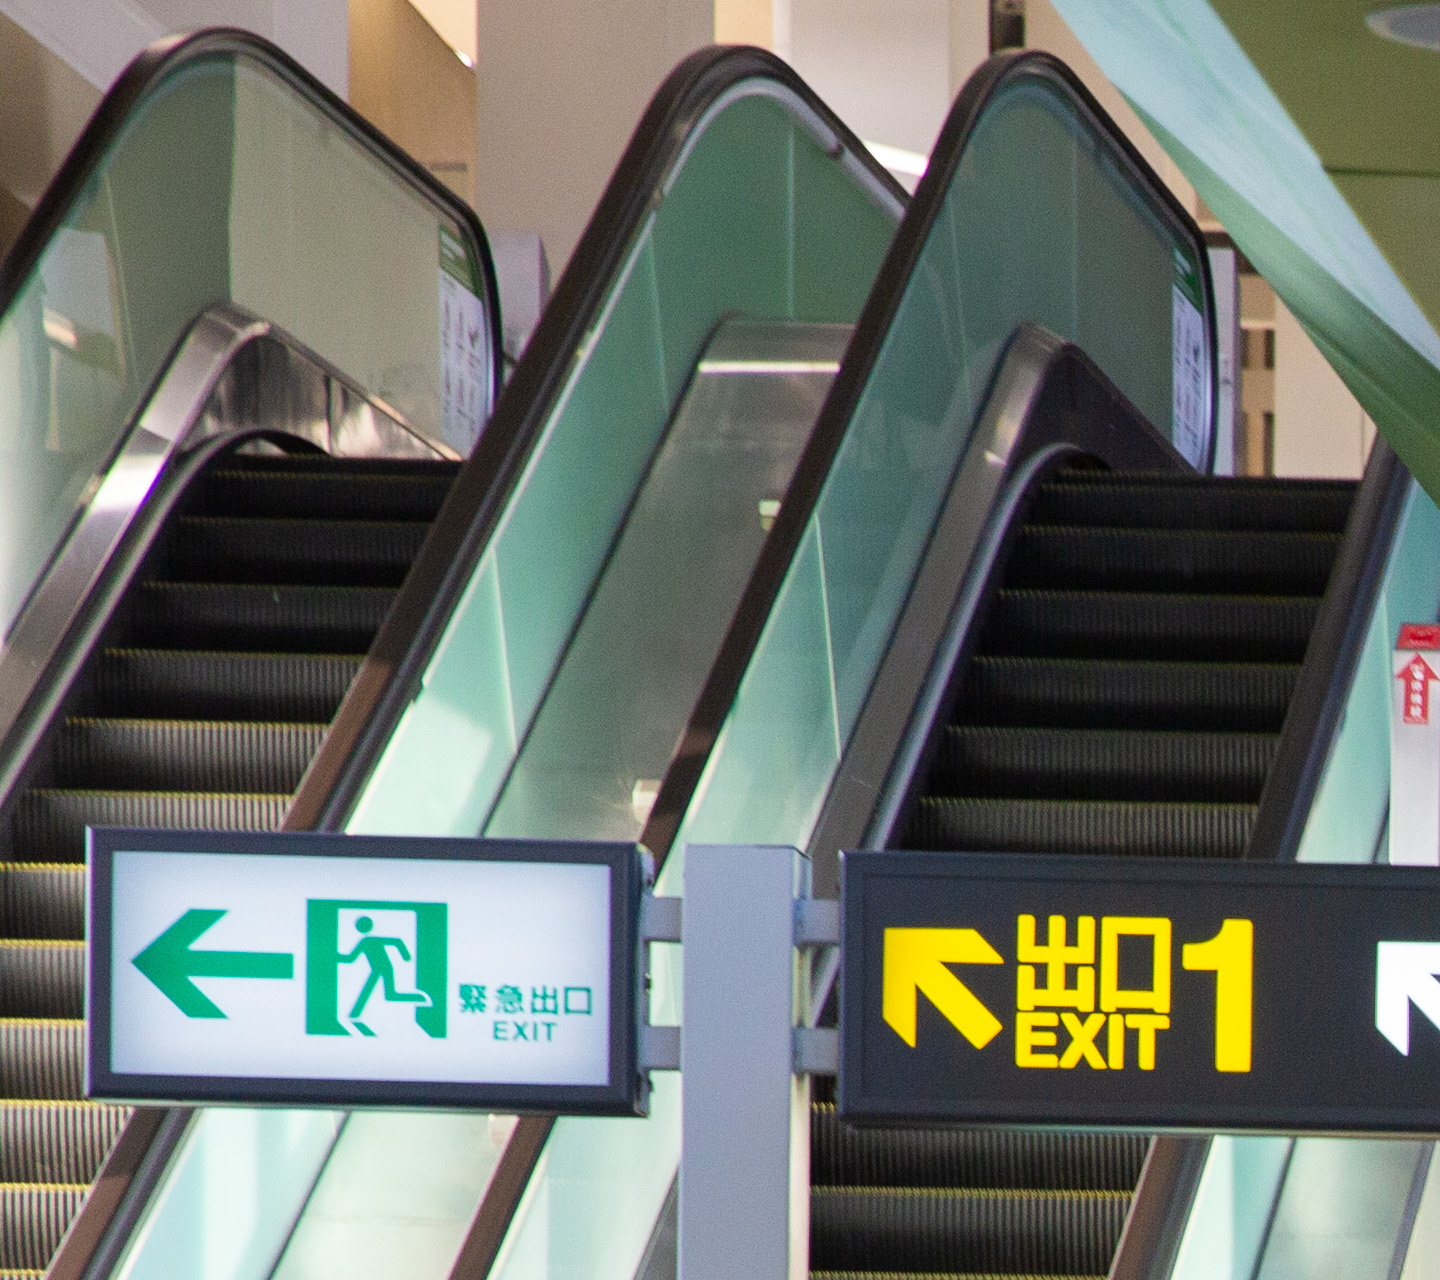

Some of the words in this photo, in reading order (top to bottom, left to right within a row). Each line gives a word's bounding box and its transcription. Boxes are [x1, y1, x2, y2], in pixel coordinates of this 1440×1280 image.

[460, 984, 592, 1015] 緊急出口
[1016, 914, 1172, 1014] 出口
[1182, 918, 1254, 1072] 1
[494, 1020, 558, 1042] EXIT
[1015, 1011, 1172, 1070] EXIT
